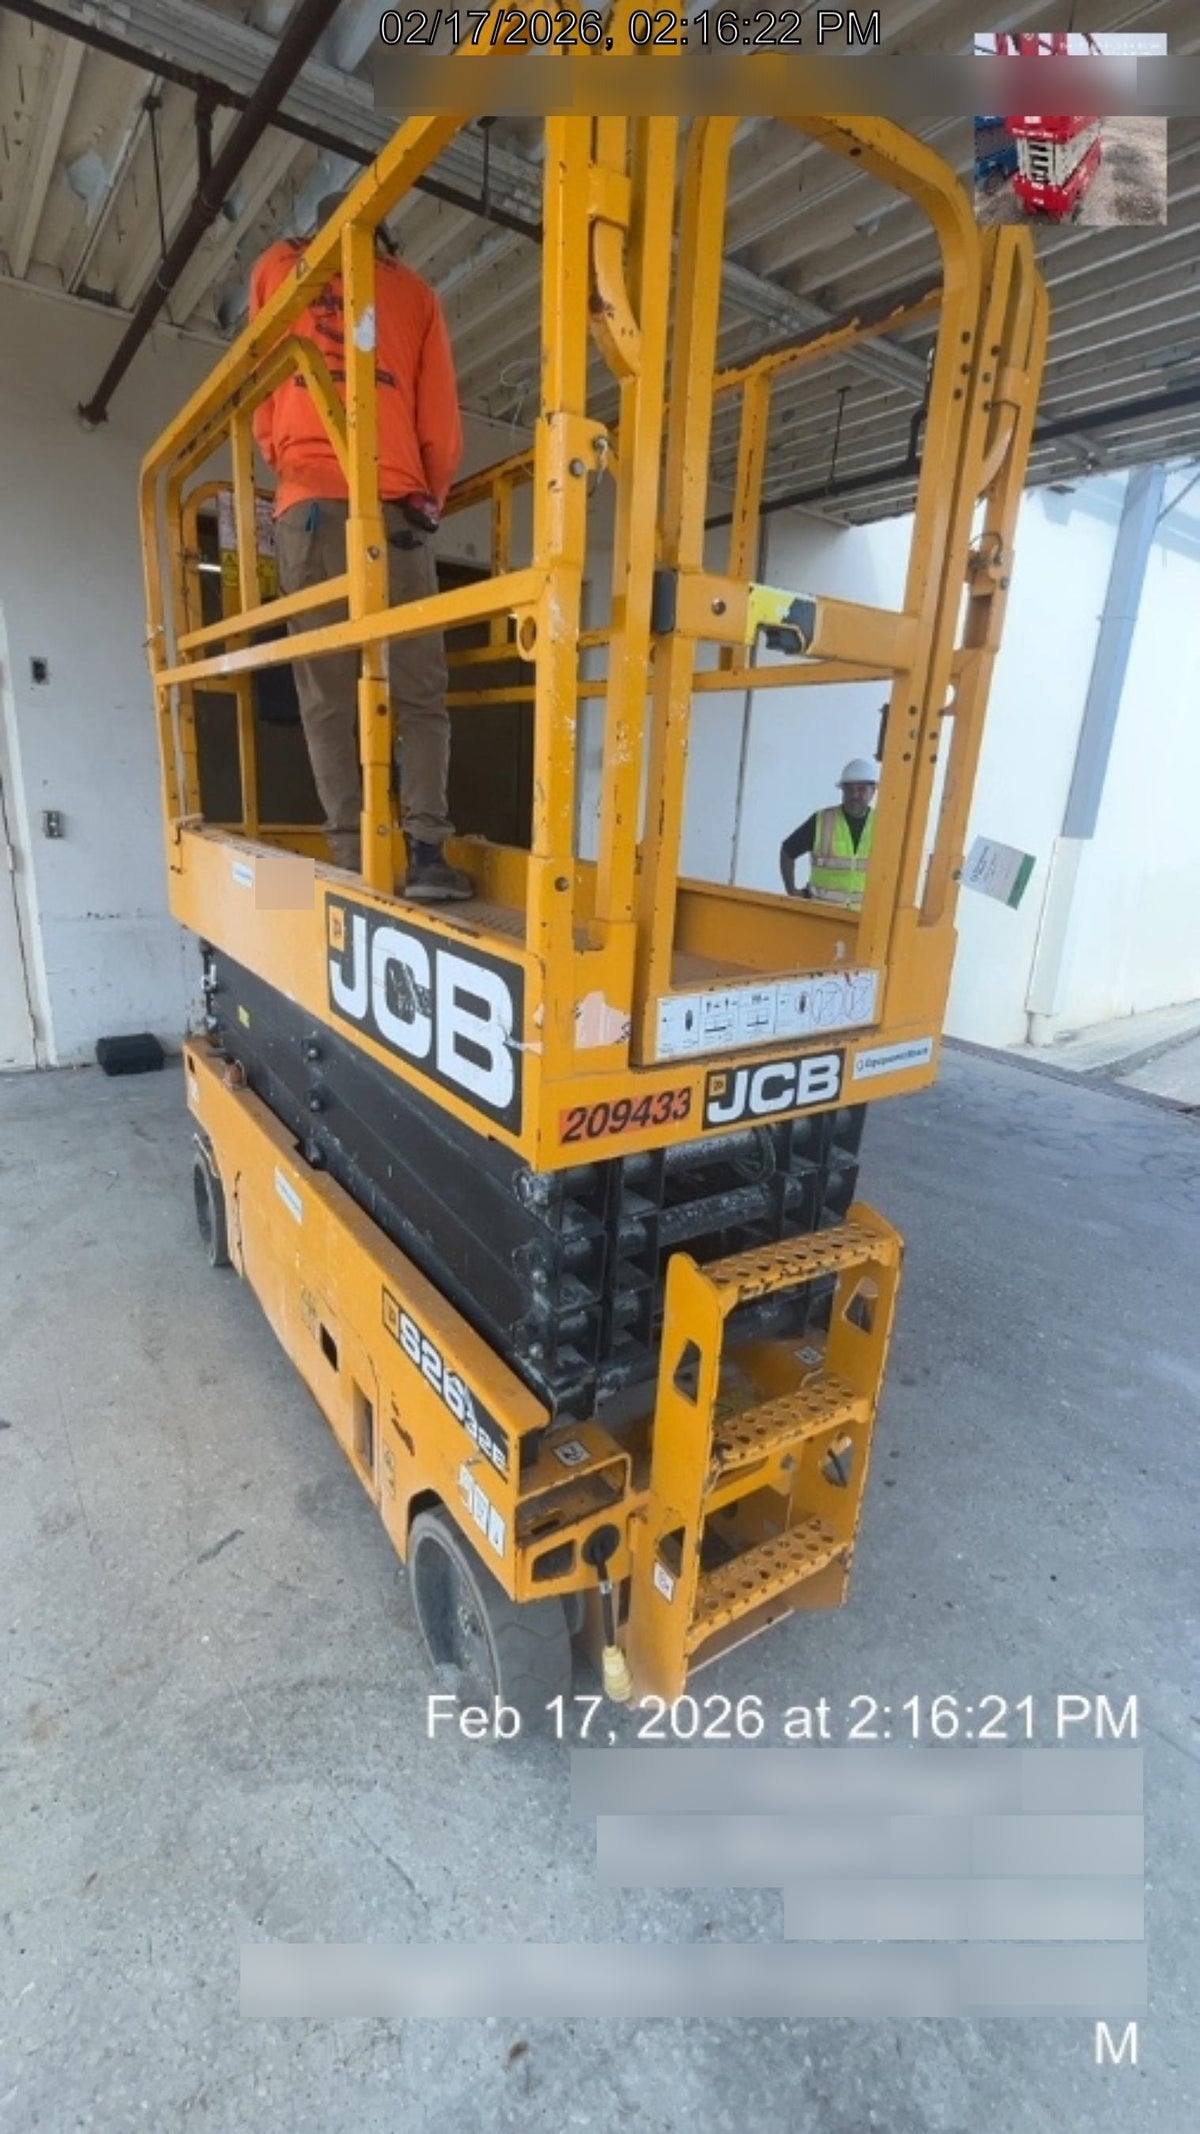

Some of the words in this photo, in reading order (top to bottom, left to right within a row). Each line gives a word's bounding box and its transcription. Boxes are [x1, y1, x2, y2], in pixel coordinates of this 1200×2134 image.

[330, 914, 514, 1109] JCB
[561, 1086, 693, 1145] 209433
[706, 1053, 841, 1124] JCB
